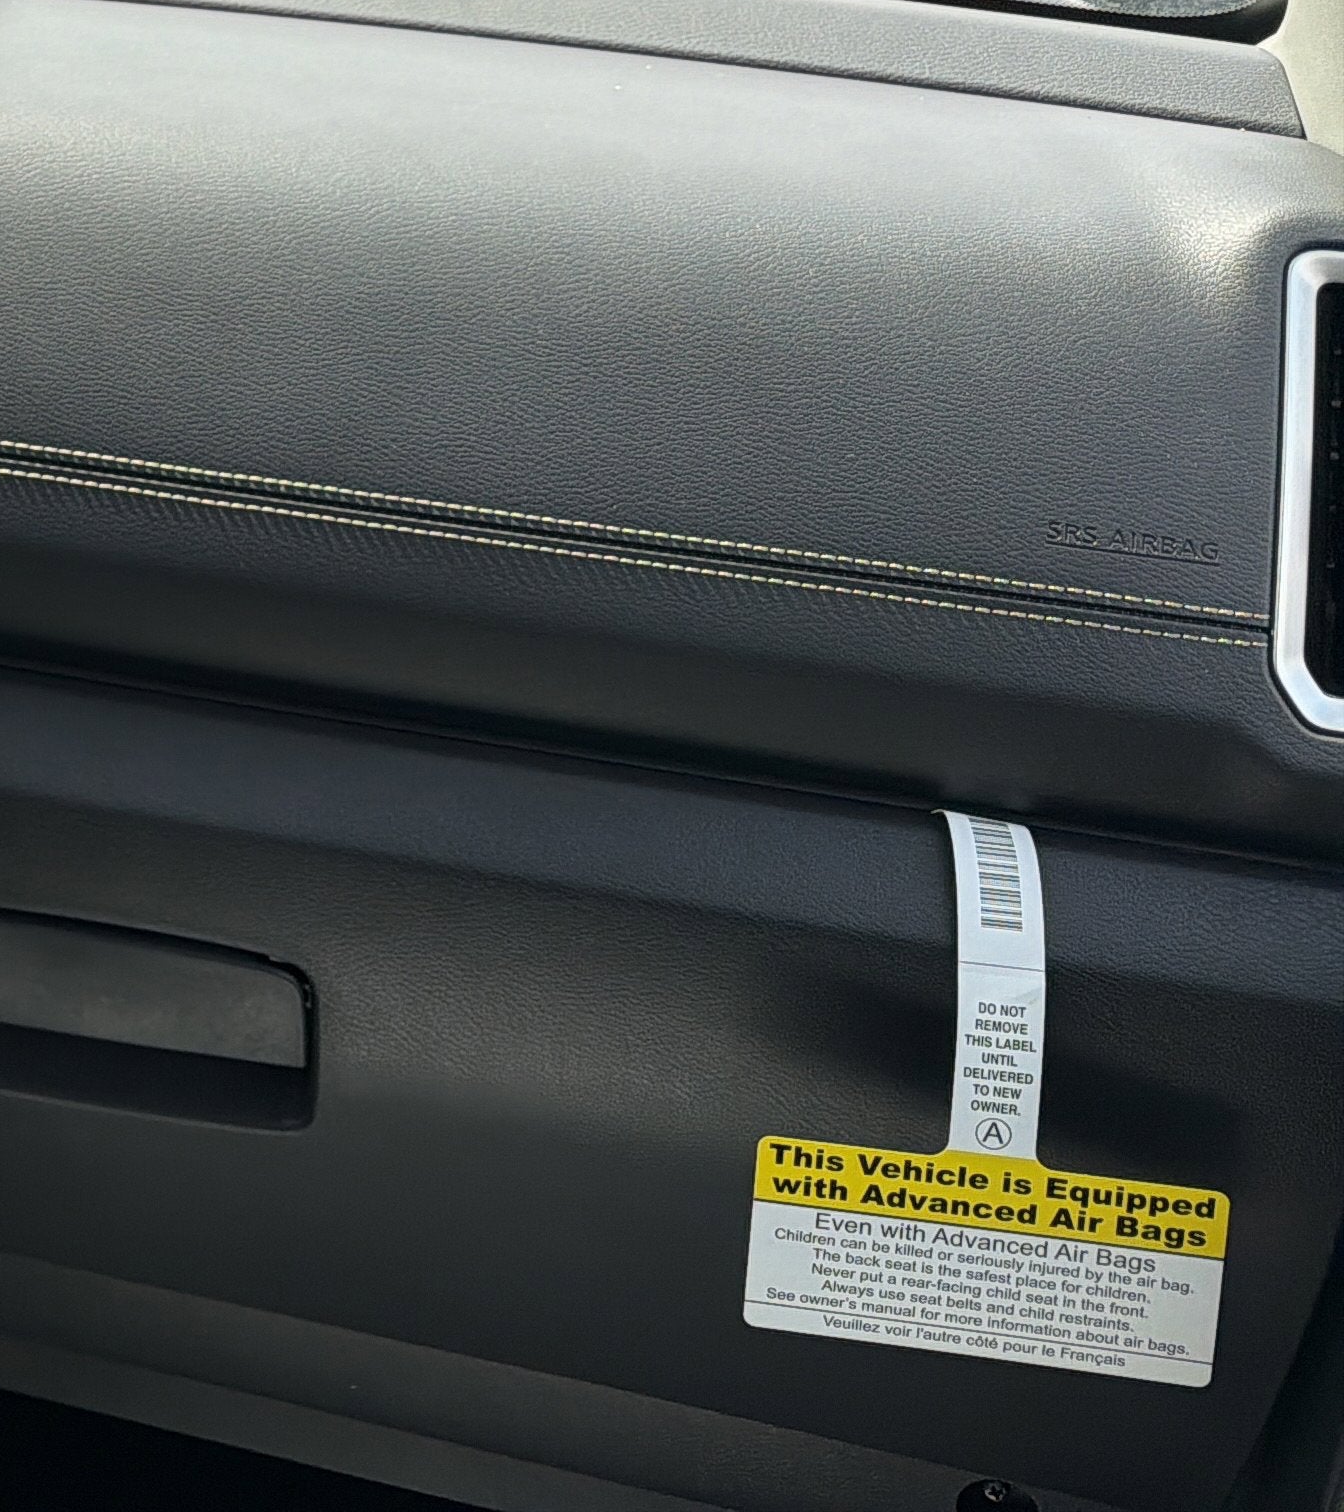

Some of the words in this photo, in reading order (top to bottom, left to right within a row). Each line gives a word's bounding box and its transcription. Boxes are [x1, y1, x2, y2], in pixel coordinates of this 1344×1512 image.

[1046, 520, 1098, 546] SRS
[1110, 528, 1220, 562] AIRBAG
[975, 1018, 1028, 1035] REMOVE
[978, 1002, 996, 1014] DO
[1000, 1004, 1026, 1018] NOT
[964, 1033, 992, 1047] THIS
[995, 1037, 1037, 1052] LABEL
[981, 1052, 1018, 1067] UNTIL
[963, 1066, 1033, 1085] DELIVERED
[972, 1083, 989, 1095] TO
[992, 1086, 1021, 1099] NEW
[970, 1099, 1021, 1116] OWNER.
[768, 1144, 844, 1172] This
[856, 1155, 989, 1190] Vehicle
[1002, 1173, 1032, 1196] is
[1045, 1178, 1215, 1223] Equipped
[771, 1173, 848, 1201] with
[860, 1184, 1037, 1225] Advanced
[1049, 1207, 1104, 1234] Air
[1115, 1215, 1207, 1251] Bags
[774, 1228, 835, 1246] Children
[840, 1239, 866, 1251] can
[871, 1241, 890, 1254] be
[894, 1244, 933, 1259] killed
[937, 1252, 953, 1262] or
[957, 1252, 1024, 1274] seriously
[1028, 1261, 1080, 1281] injured
[1084, 1268, 1103, 1284] by
[1108, 1271, 1132, 1285] the
[1136, 1275, 1157, 1289] air
[1160, 1278, 1194, 1296] bag.
[815, 1213, 872, 1235] Even
[879, 1221, 926, 1242] with
[932, 1228, 1048, 1258] Advanced
[1054, 1243, 1088, 1263] Air
[1095, 1249, 1156, 1276] Bags
[811, 1263, 856, 1279] Never
[859, 1270, 883, 1285] put
[887, 1276, 896, 1285] a
[901, 1275, 981, 1298] rear-facing
[986, 1286, 1021, 1301] child
[1025, 1291, 1058, 1306] seat
[1063, 1296, 1075, 1308] in
[1080, 1299, 1105, 1312] the
[1109, 1302, 1149, 1318] front.
[812, 1248, 841, 1262] The
[845, 1252, 880, 1268] back
[884, 1258, 916, 1272] seat
[921, 1262, 933, 1275] is
[937, 1265, 961, 1278] the
[966, 1268, 1011, 1285] safest
[1015, 1275, 1056, 1293] place
[1060, 1281, 1082, 1294] for
[1085, 1284, 1151, 1303] children.
[766, 1288, 795, 1302] See
[799, 1292, 856, 1310] owner's
[861, 1300, 915, 1318] manual
[920, 1308, 940, 1321] for
[944, 1314, 982, 1327] more
[987, 1317, 1071, 1339] information
[1075, 1329, 1119, 1346] about
[1123, 1335, 1144, 1349] air
[1147, 1339, 1190, 1358] bags.
[821, 1280, 874, 1300] Always
[878, 1290, 905, 1301] use
[910, 1292, 942, 1306] seat
[946, 1296, 982, 1312] belts
[986, 1302, 1014, 1316] and
[1019, 1306, 1054, 1321] child
[1059, 1311, 1134, 1332] restraints.
[822, 1315, 880, 1333] Veuillez
[884, 1323, 912, 1337] voir
[916, 1328, 961, 1344] l'autre
[965, 1334, 998, 1349] côté
[1002, 1339, 1038, 1357] pour
[1041, 1345, 1055, 1357] le
[1060, 1347, 1125, 1369] Français
